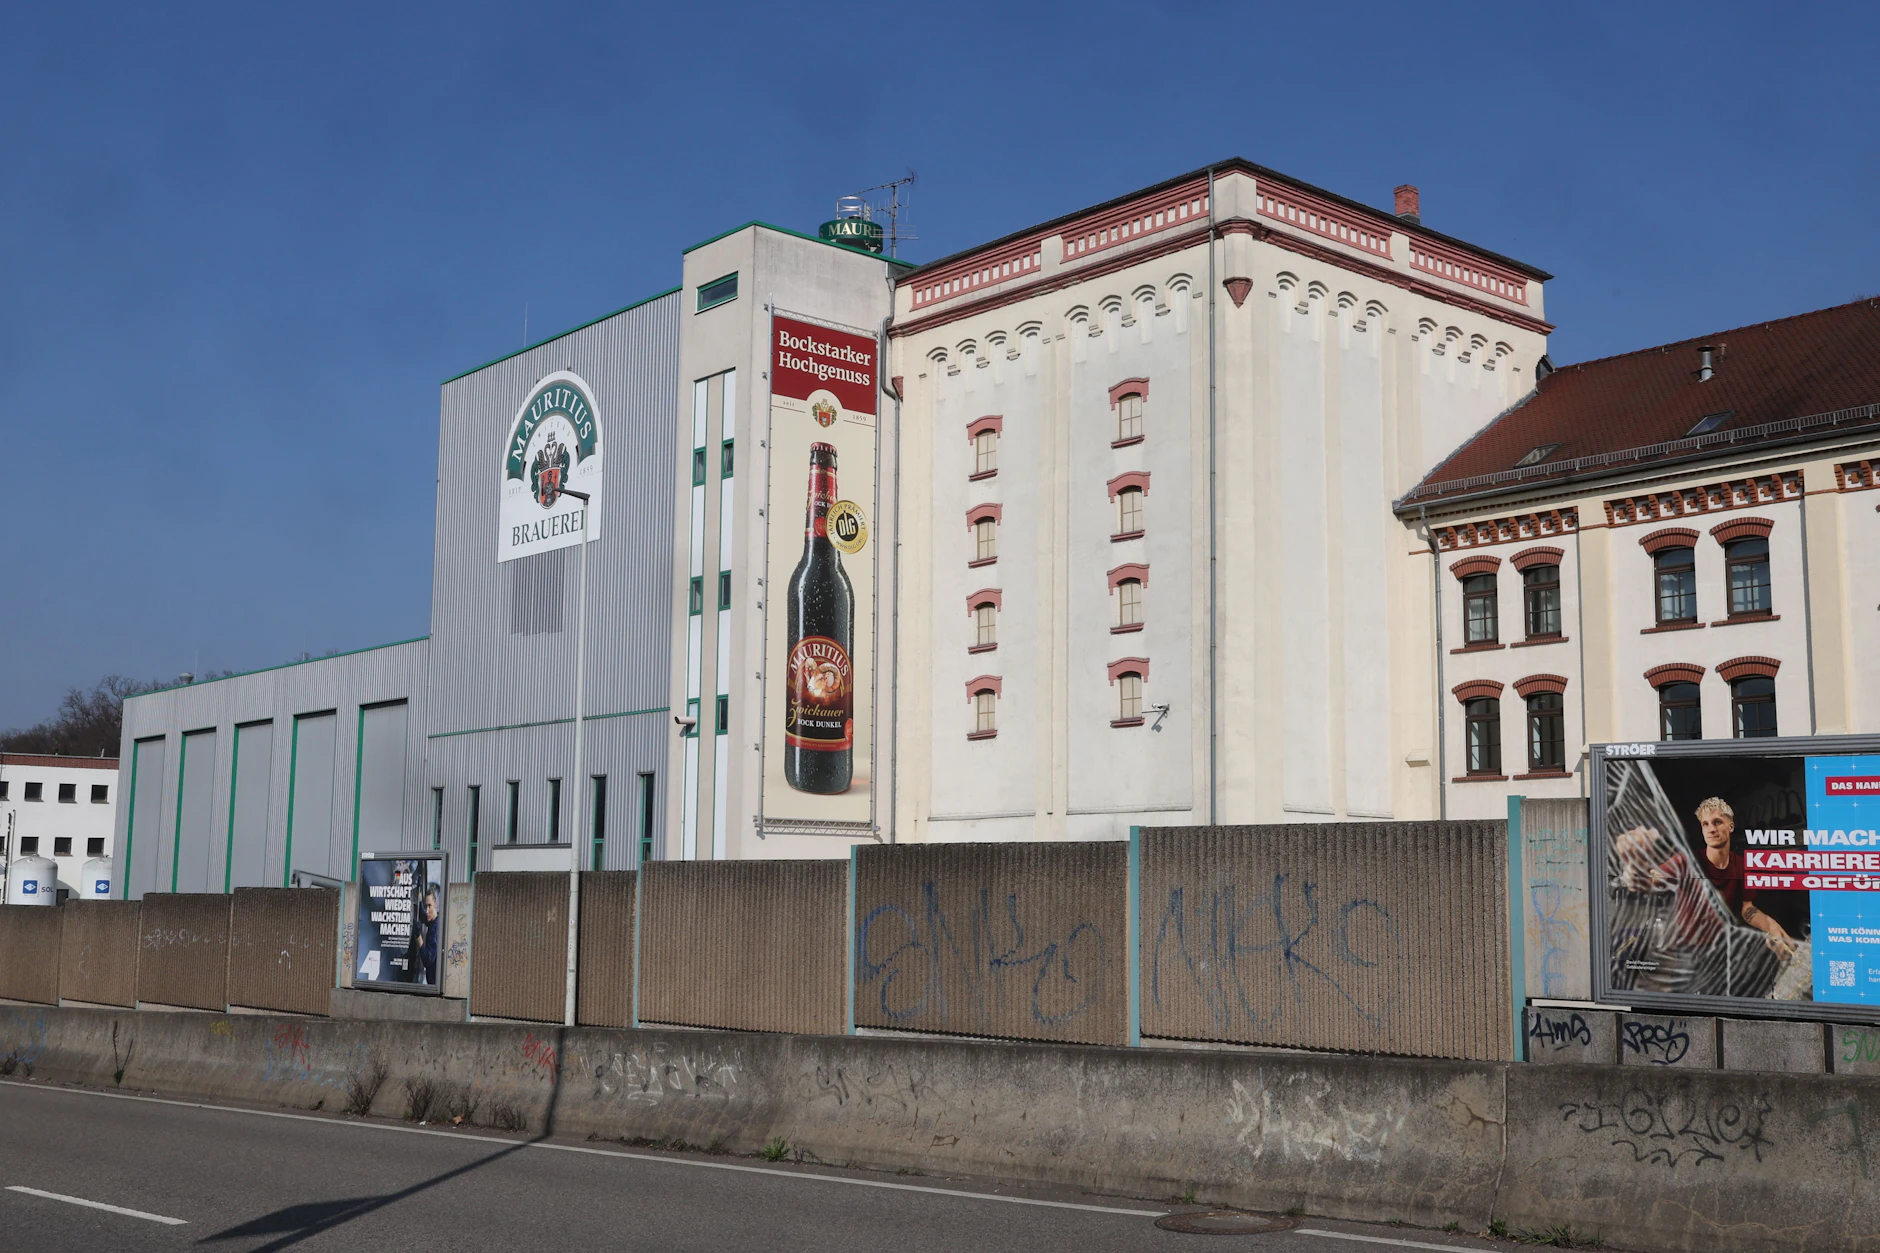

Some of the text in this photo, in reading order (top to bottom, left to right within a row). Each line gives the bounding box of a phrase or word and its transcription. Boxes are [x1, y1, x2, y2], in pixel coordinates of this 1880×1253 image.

[779, 330, 871, 366] Bockstarker
[778, 351, 870, 386] Hochgenuss
[511, 388, 592, 462] MAURITIUS
[512, 509, 584, 547] BRAUEREI
[838, 511, 857, 536] DLG
[790, 643, 849, 676] MAURITIUS
[787, 698, 844, 728] Zwickauer
[797, 718, 842, 728] BOCK DUNKEL
[1606, 743, 1656, 756] STRÖER
[1831, 781, 1880, 790] DAS HAN
[1745, 829, 1796, 845] WIR
[1746, 852, 1880, 870] KARRIERE
[399, 873, 412, 885] AUS
[1747, 875, 1795, 888] MIT
[370, 886, 412, 898] WIRTSCHAFT
[385, 899, 411, 911] WIEDER
[371, 911, 410, 923] WACHSTUM
[380, 923, 410, 935] MACHEN
[1828, 935, 1852, 943] WAS
